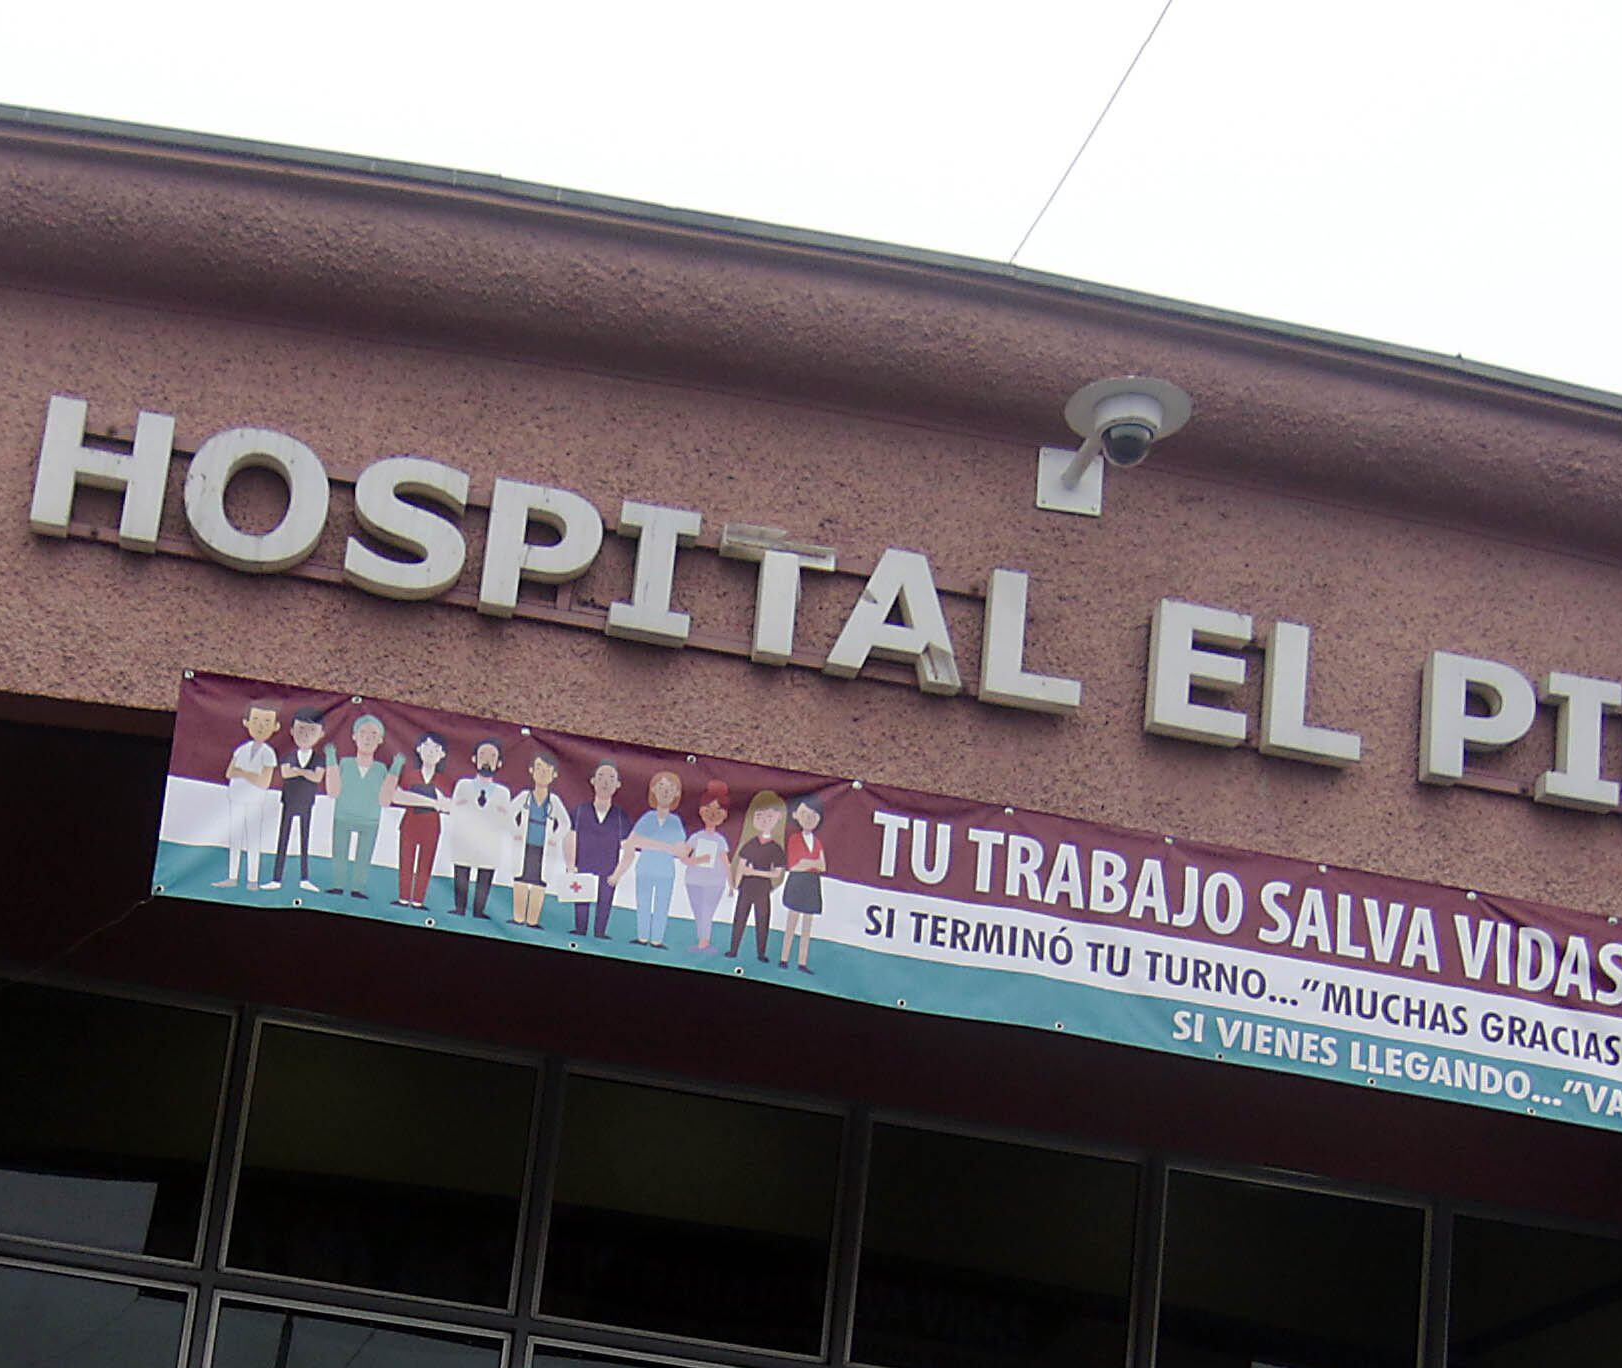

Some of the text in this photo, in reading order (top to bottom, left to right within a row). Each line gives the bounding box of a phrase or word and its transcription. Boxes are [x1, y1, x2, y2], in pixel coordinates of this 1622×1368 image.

[30, 395, 1082, 714] HOSPITAL
[1144, 598, 1360, 768] EL
[872, 809, 951, 884] TU
[968, 827, 1243, 935] TRABAJO
[1258, 881, 1441, 974] SALVA
[865, 904, 895, 938] SI
[910, 911, 1074, 966] TERMINÓ
[1086, 941, 1131, 977] TU
[1480, 1011, 1621, 1067] GRACIAS
[1172, 1010, 1204, 1043] SI
[1216, 1016, 1338, 1067] VIENES
